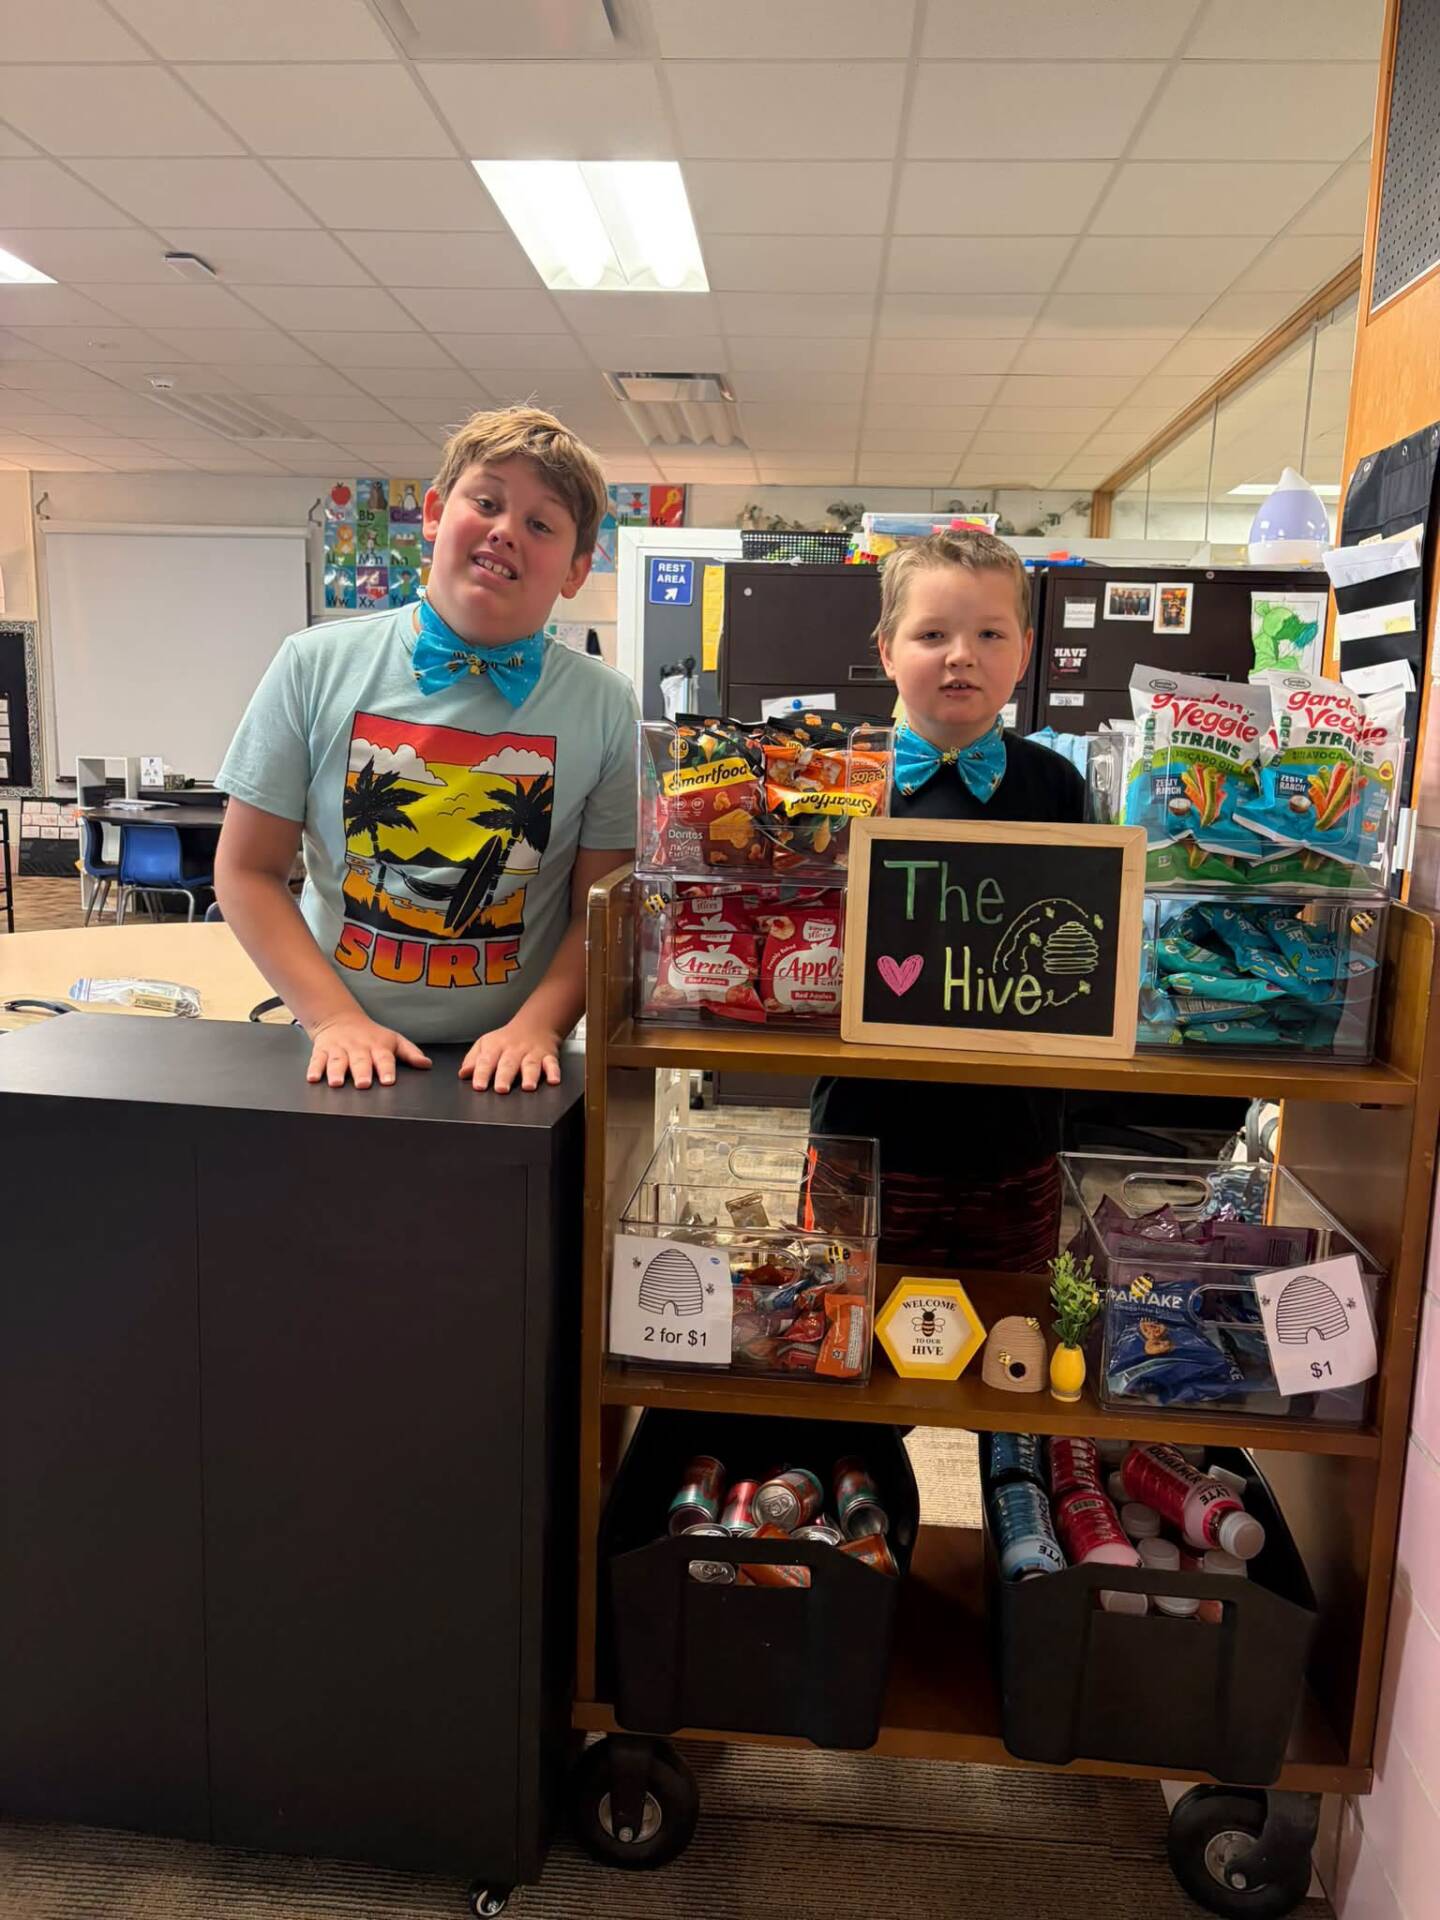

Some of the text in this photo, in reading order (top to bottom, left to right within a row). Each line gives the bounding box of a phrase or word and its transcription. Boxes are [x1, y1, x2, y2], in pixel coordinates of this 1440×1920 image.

[359, 510, 375, 520] Bb
[658, 563, 687, 573] REST
[657, 574, 686, 584] AREA
[360, 597, 375, 608] Xx
[1054, 648, 1087, 658] HAVE
[1171, 703, 1259, 743] Veggie
[1171, 731, 1242, 759] STRAWS
[669, 763, 748, 791] Smartfood
[668, 829, 703, 840] Doritos
[883, 860, 1005, 924] The
[334, 921, 521, 988] SURF
[944, 946, 1042, 1015] Hive
[902, 1299, 958, 1312] WELCOME
[644, 1326, 707, 1347] 2 for $1
[912, 1345, 944, 1357] HIVE
[1310, 1360, 1333, 1378] $1
